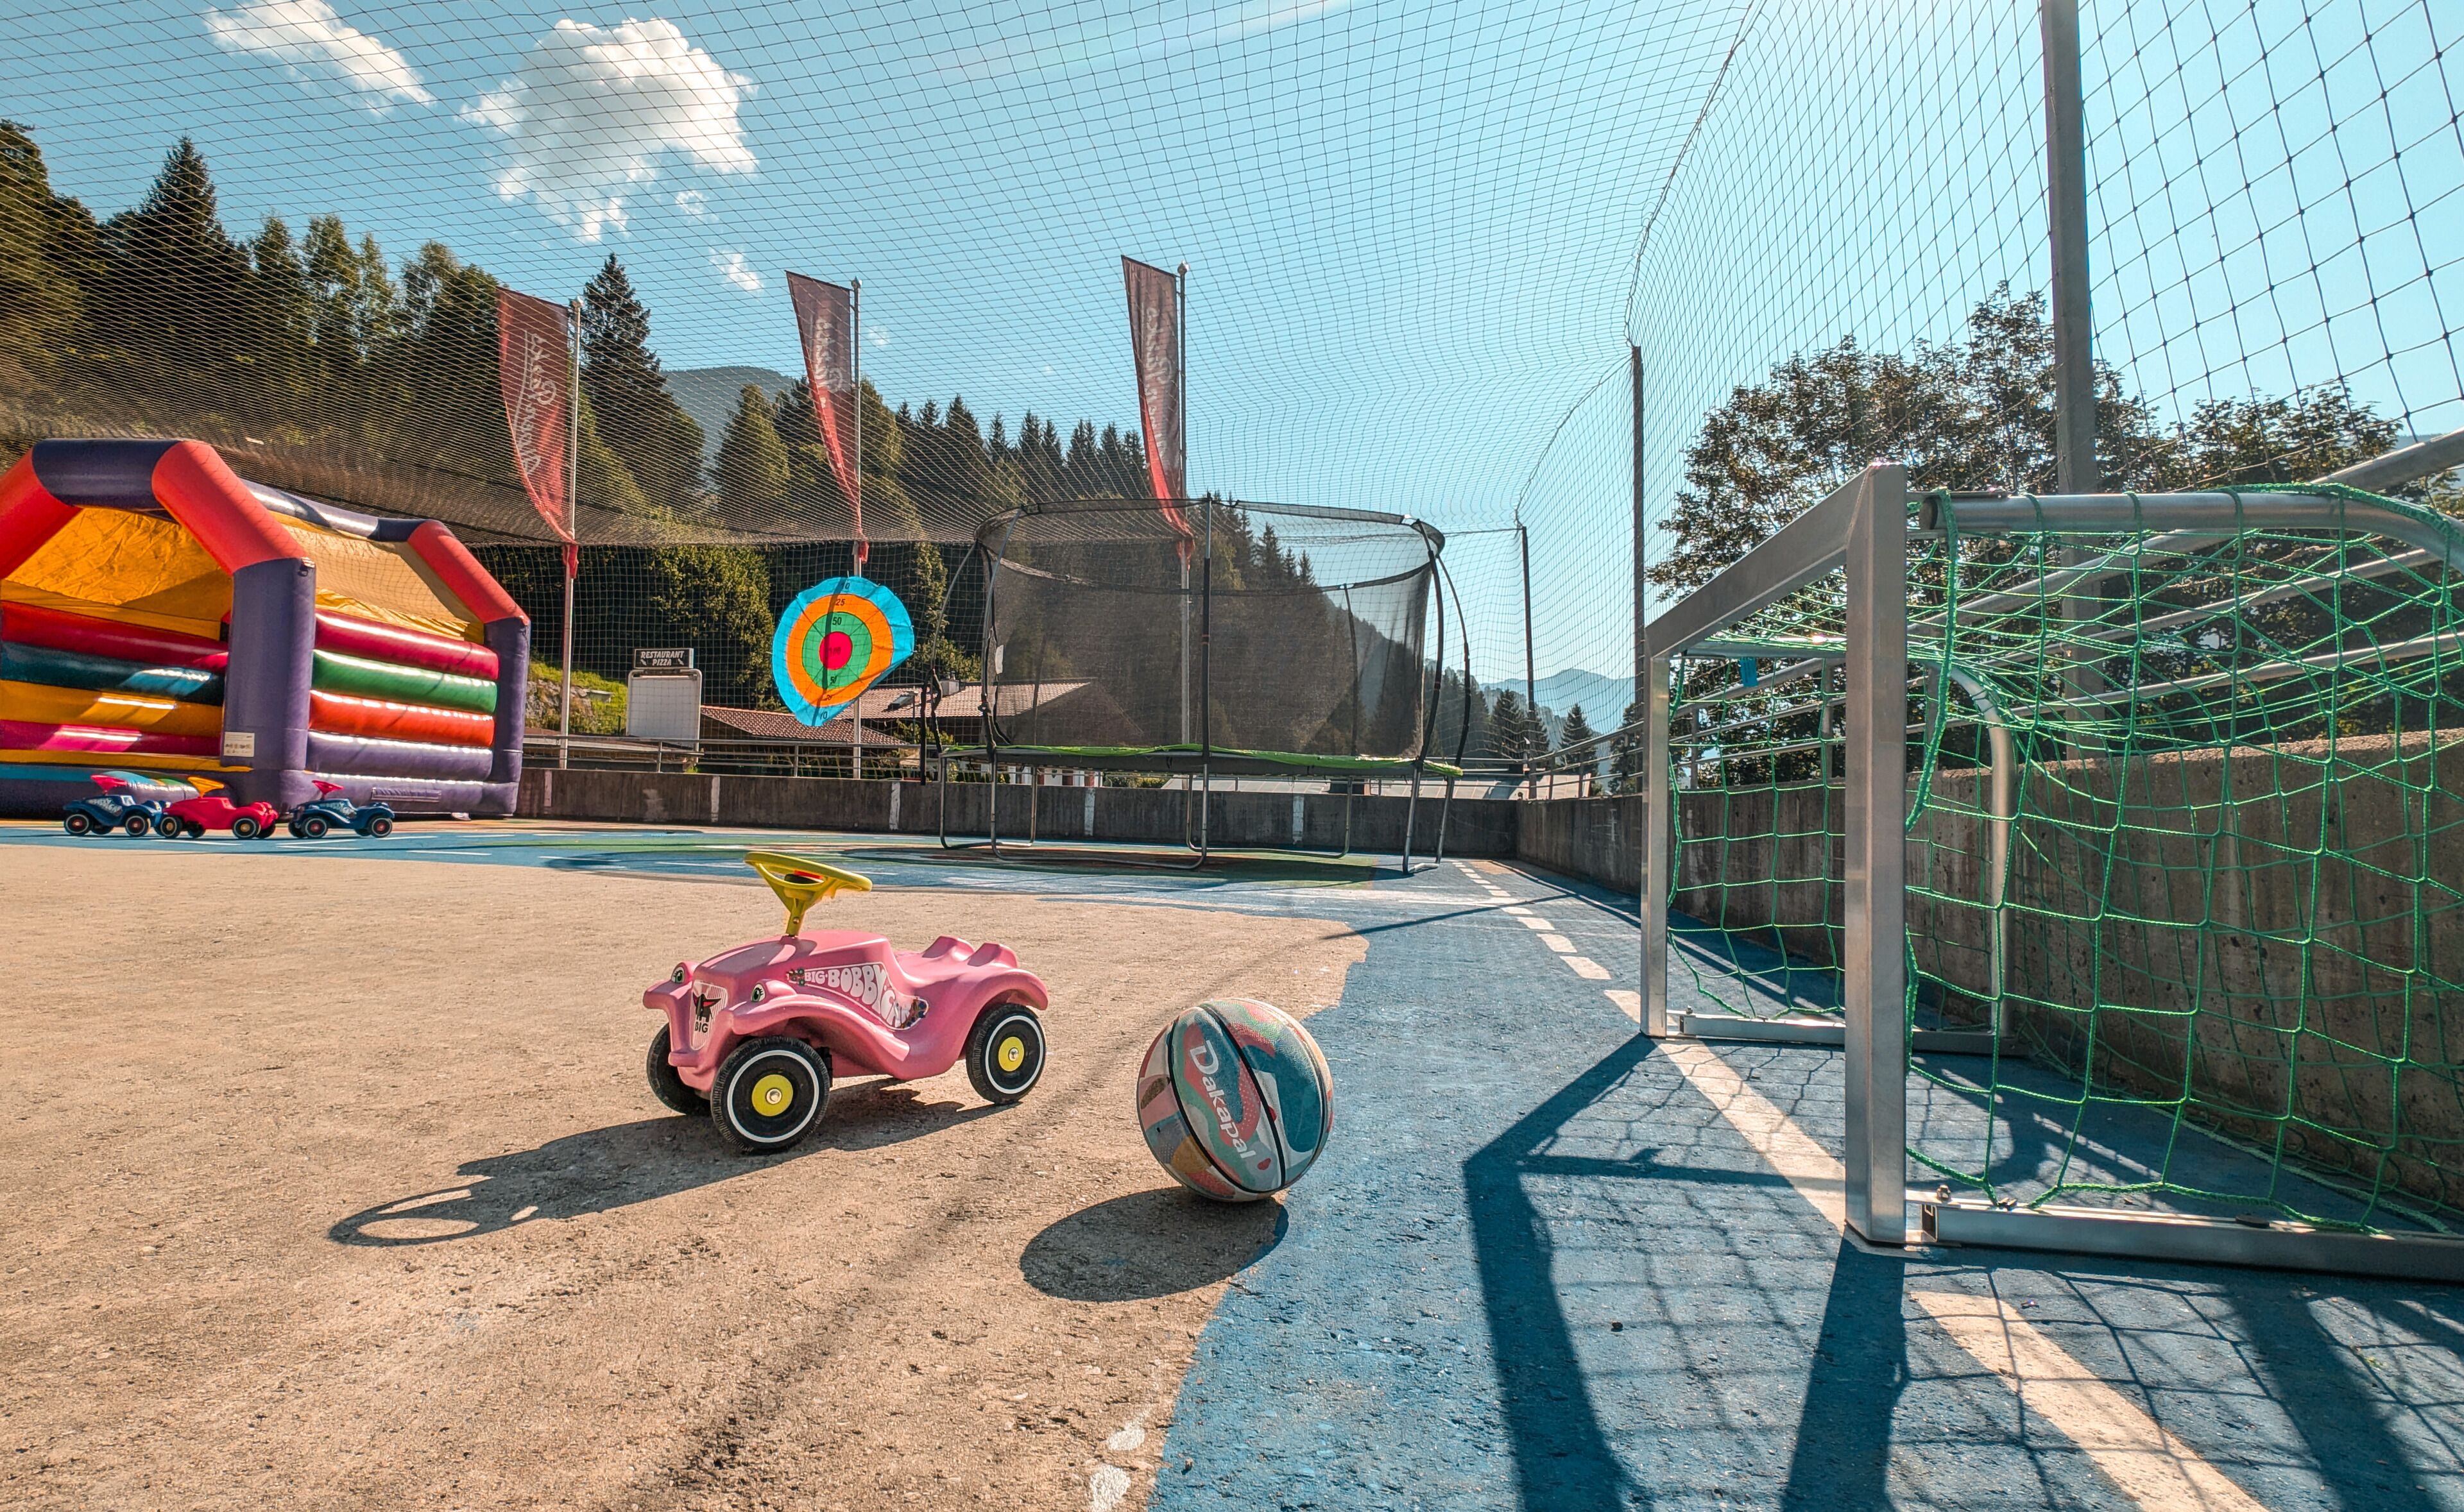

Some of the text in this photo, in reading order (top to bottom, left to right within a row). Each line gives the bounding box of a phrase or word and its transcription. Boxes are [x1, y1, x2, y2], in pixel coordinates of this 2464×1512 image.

[835, 598, 846, 606] 25
[832, 616, 842, 625] 50
[640, 650, 685, 659] RESTAURANT
[695, 1021, 708, 1033] BIG
[1190, 1040, 1256, 1159] Dakapal
